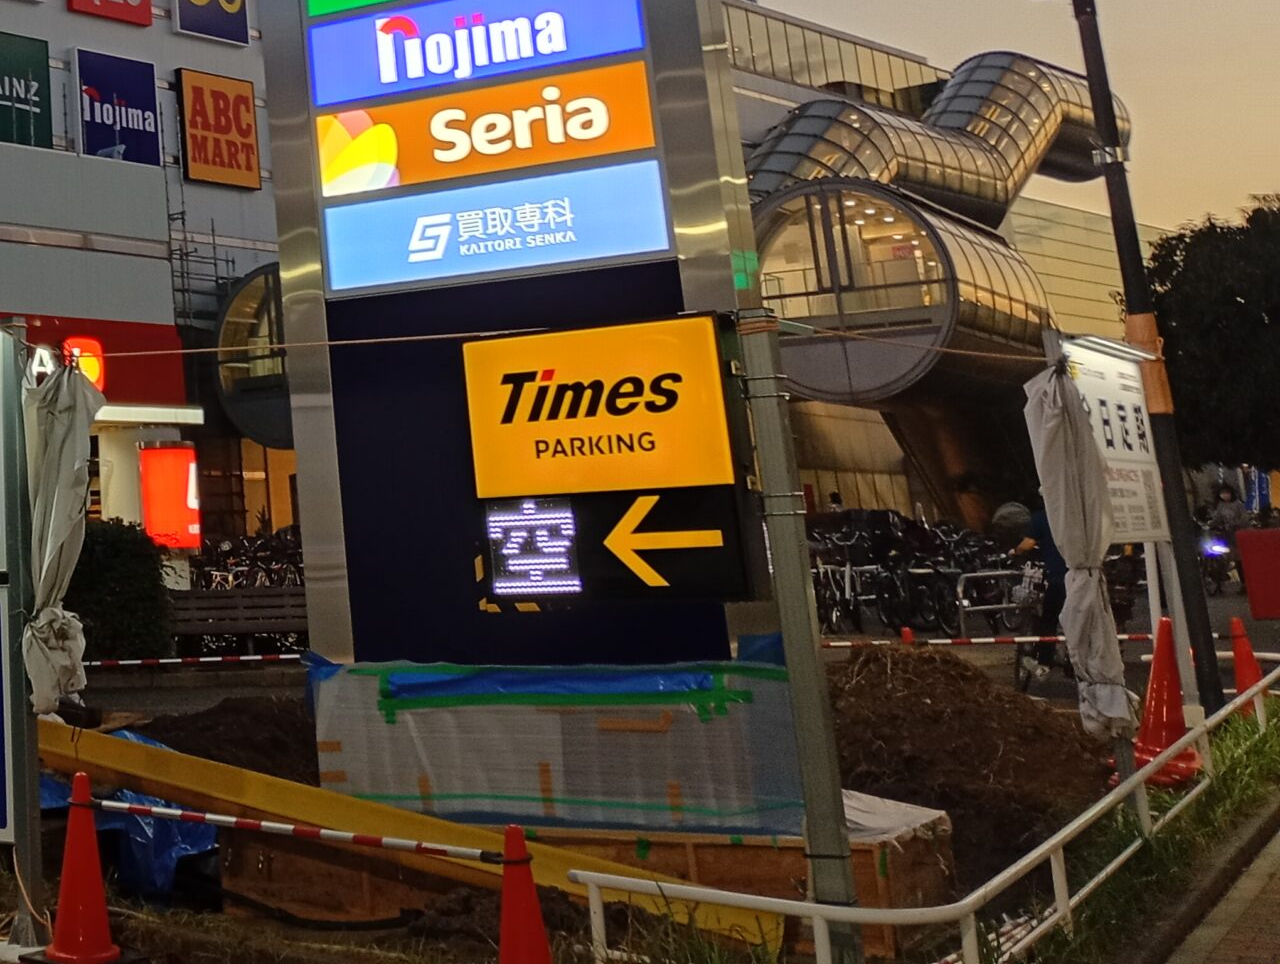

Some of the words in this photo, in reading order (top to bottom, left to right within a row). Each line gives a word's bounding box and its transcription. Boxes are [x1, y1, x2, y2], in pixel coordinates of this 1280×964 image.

[375, 11, 567, 84] nojima
[189, 86, 252, 135] ABC
[430, 86, 610, 163] Seria
[190, 132, 255, 172] MART
[456, 197, 574, 242] 買取専科
[460, 237, 522, 256] KAITORI
[526, 230, 577, 248] SENKA
[500, 368, 683, 425] Times
[536, 431, 655, 459] PARKING
